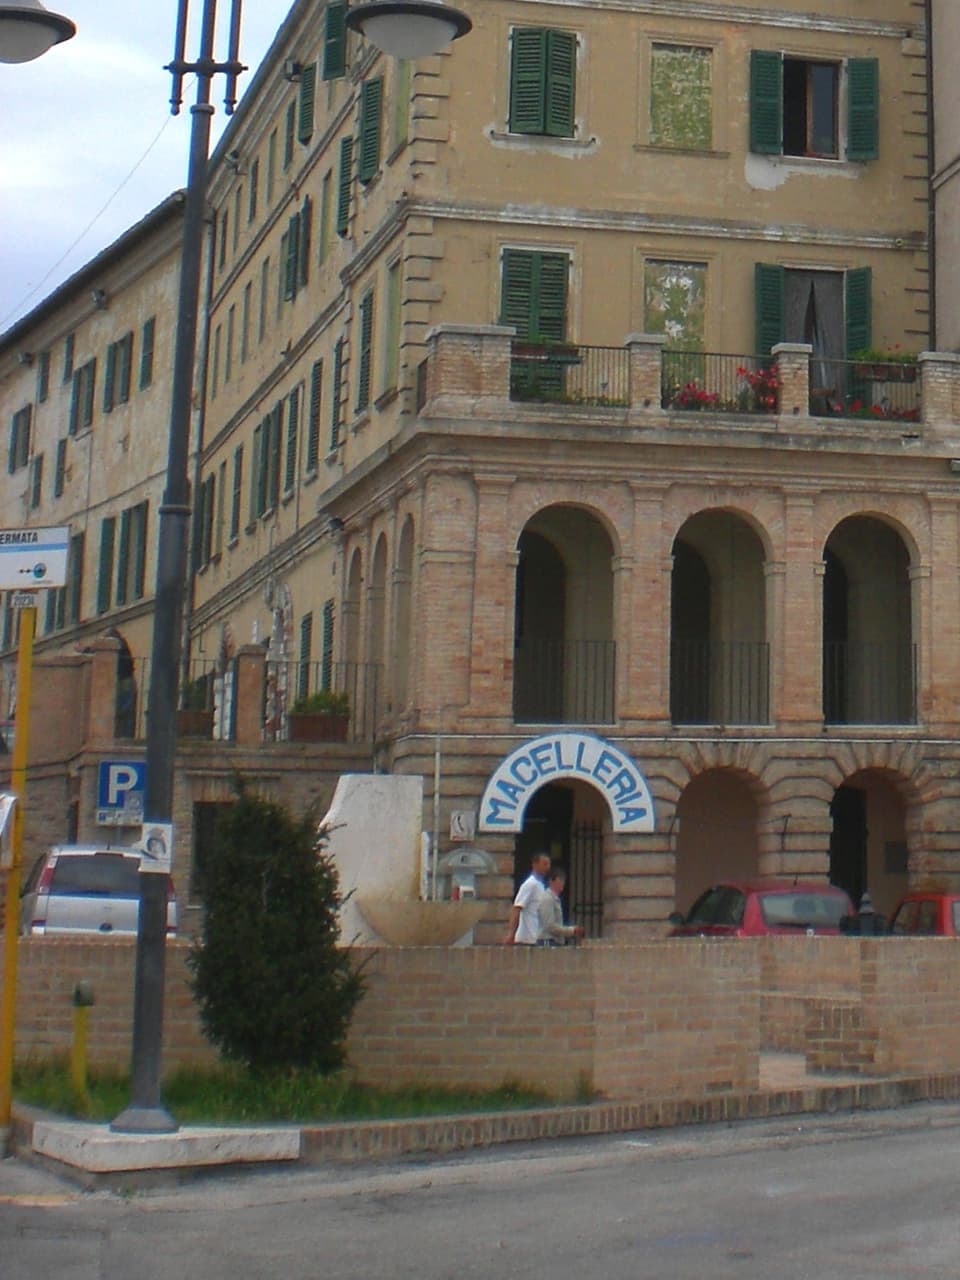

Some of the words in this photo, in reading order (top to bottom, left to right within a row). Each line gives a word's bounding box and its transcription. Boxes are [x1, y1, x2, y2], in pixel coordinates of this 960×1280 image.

[0, 532, 38, 544] ERMATA
[107, 765, 138, 804] P
[485, 740, 648, 825] MACELLERIA
